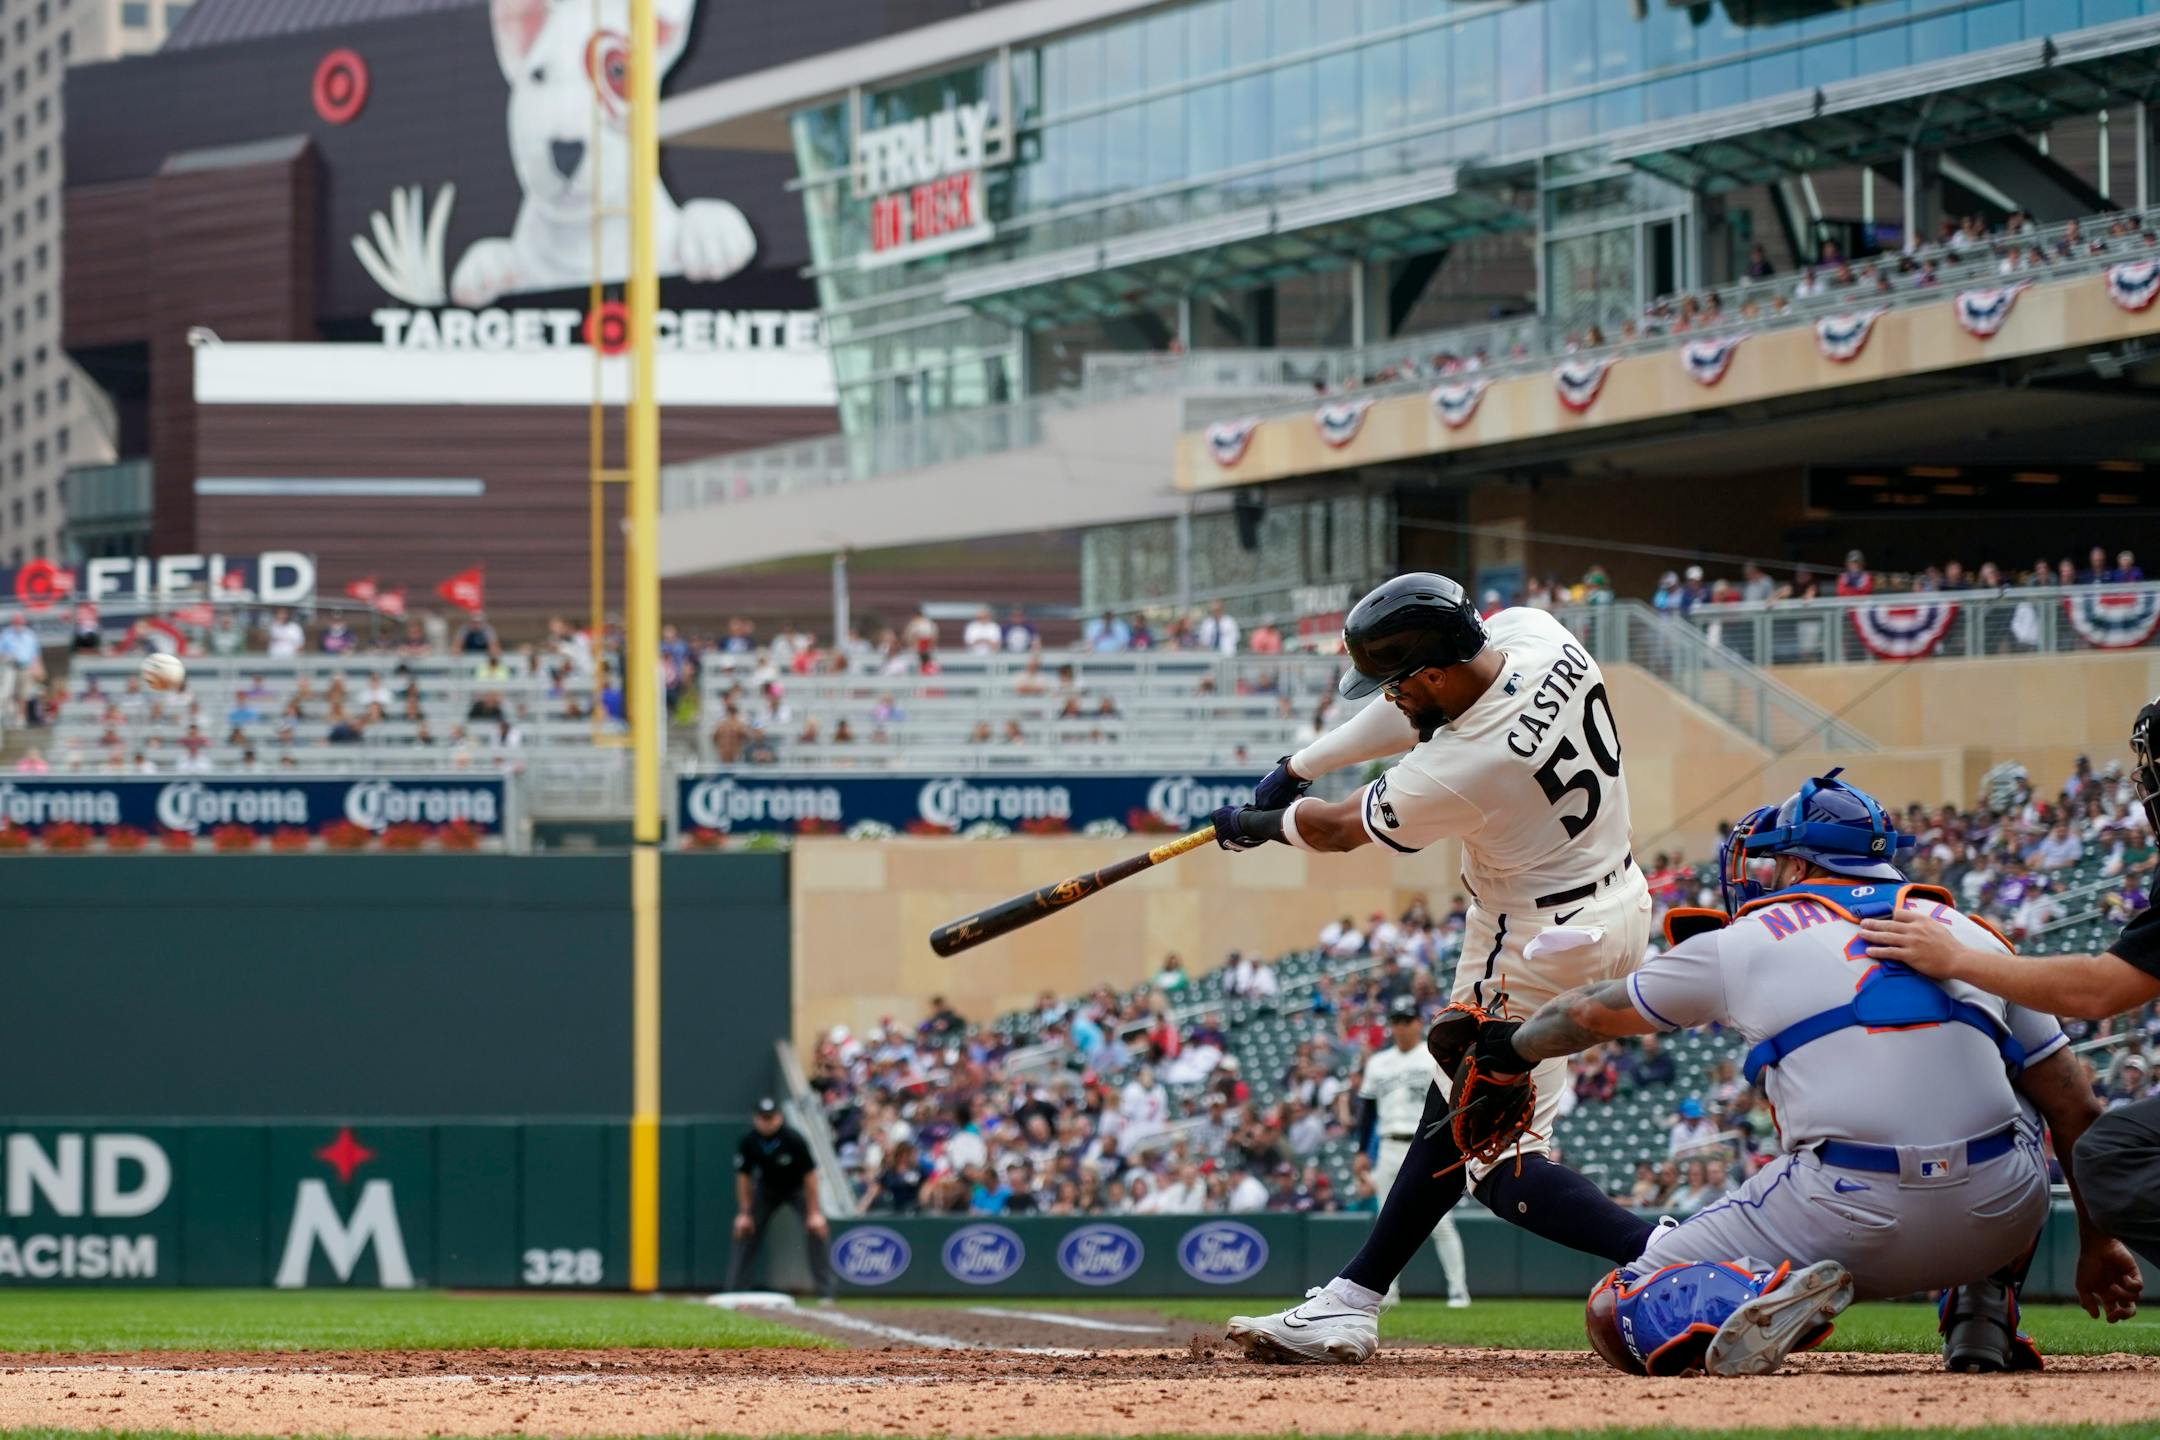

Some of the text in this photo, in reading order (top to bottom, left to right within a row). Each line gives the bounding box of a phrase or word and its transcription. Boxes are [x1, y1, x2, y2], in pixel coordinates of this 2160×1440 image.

[858, 102, 989, 195] TRULY
[372, 308, 828, 350] TARGET CENTE
[87, 551, 315, 603] FIELD
[1507, 643, 1588, 757] CASTRO
[1532, 682, 1622, 840] 50
[156, 782, 310, 834] Corona
[344, 781, 497, 833] Corona
[688, 778, 841, 832] Corona
[917, 777, 1071, 831] Corona
[1147, 776, 1257, 830] Coro
[0, 1132, 172, 1218] ND
[522, 1247, 604, 1285] 328
[844, 1235, 897, 1276] Ford
[957, 1233, 1011, 1276] Ford
[1072, 1232, 1129, 1276] Ford
[1193, 1229, 1252, 1275] Ford
